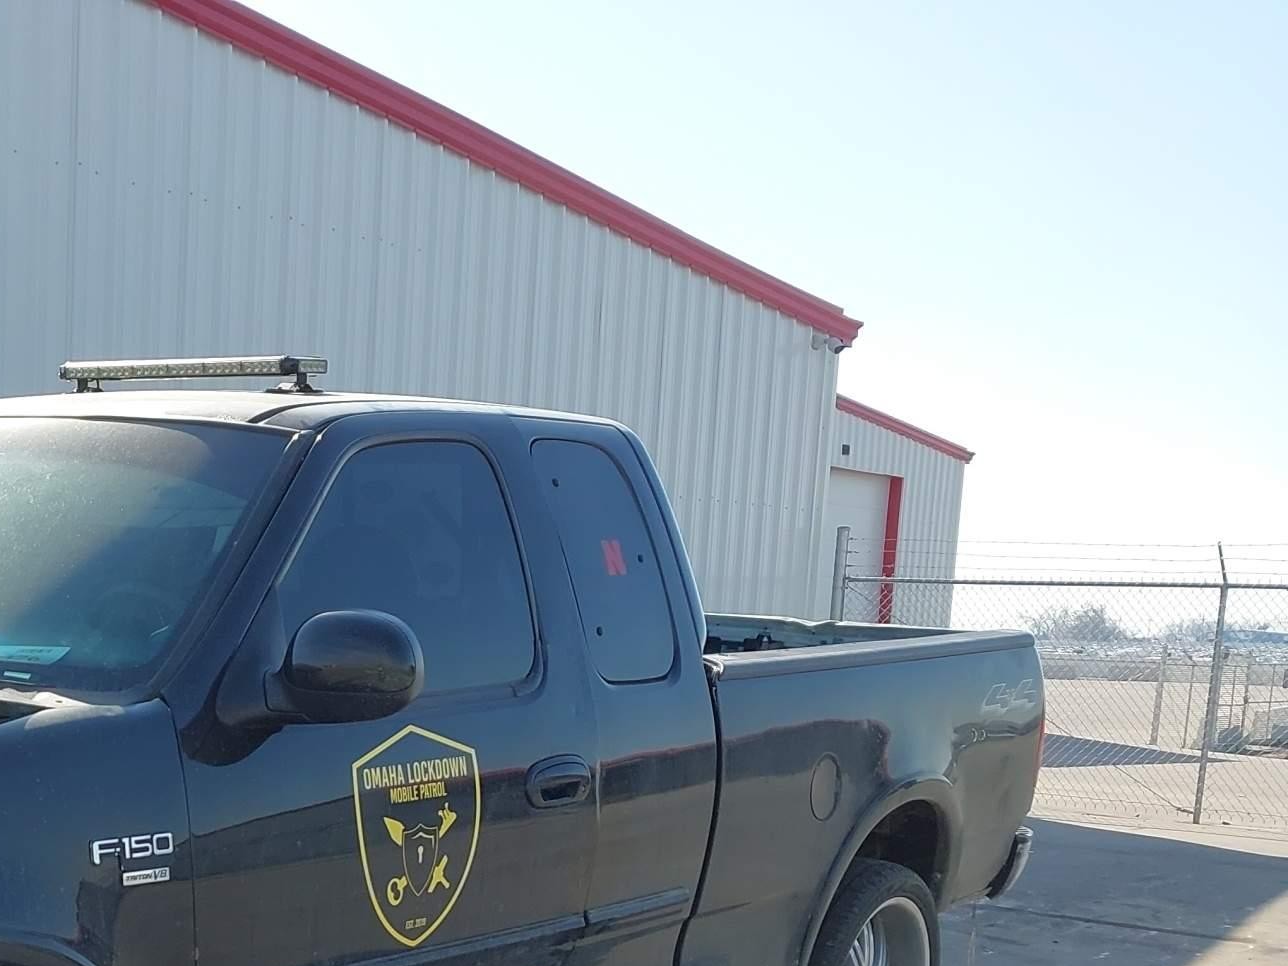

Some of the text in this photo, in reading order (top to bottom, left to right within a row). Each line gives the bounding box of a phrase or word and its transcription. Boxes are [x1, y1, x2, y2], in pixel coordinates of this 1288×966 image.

[363, 756, 468, 790] OMAHA LOCKDOWN
[390, 781, 448, 804] MOBILE PATROL
[126, 869, 167, 882] TRITON V8
